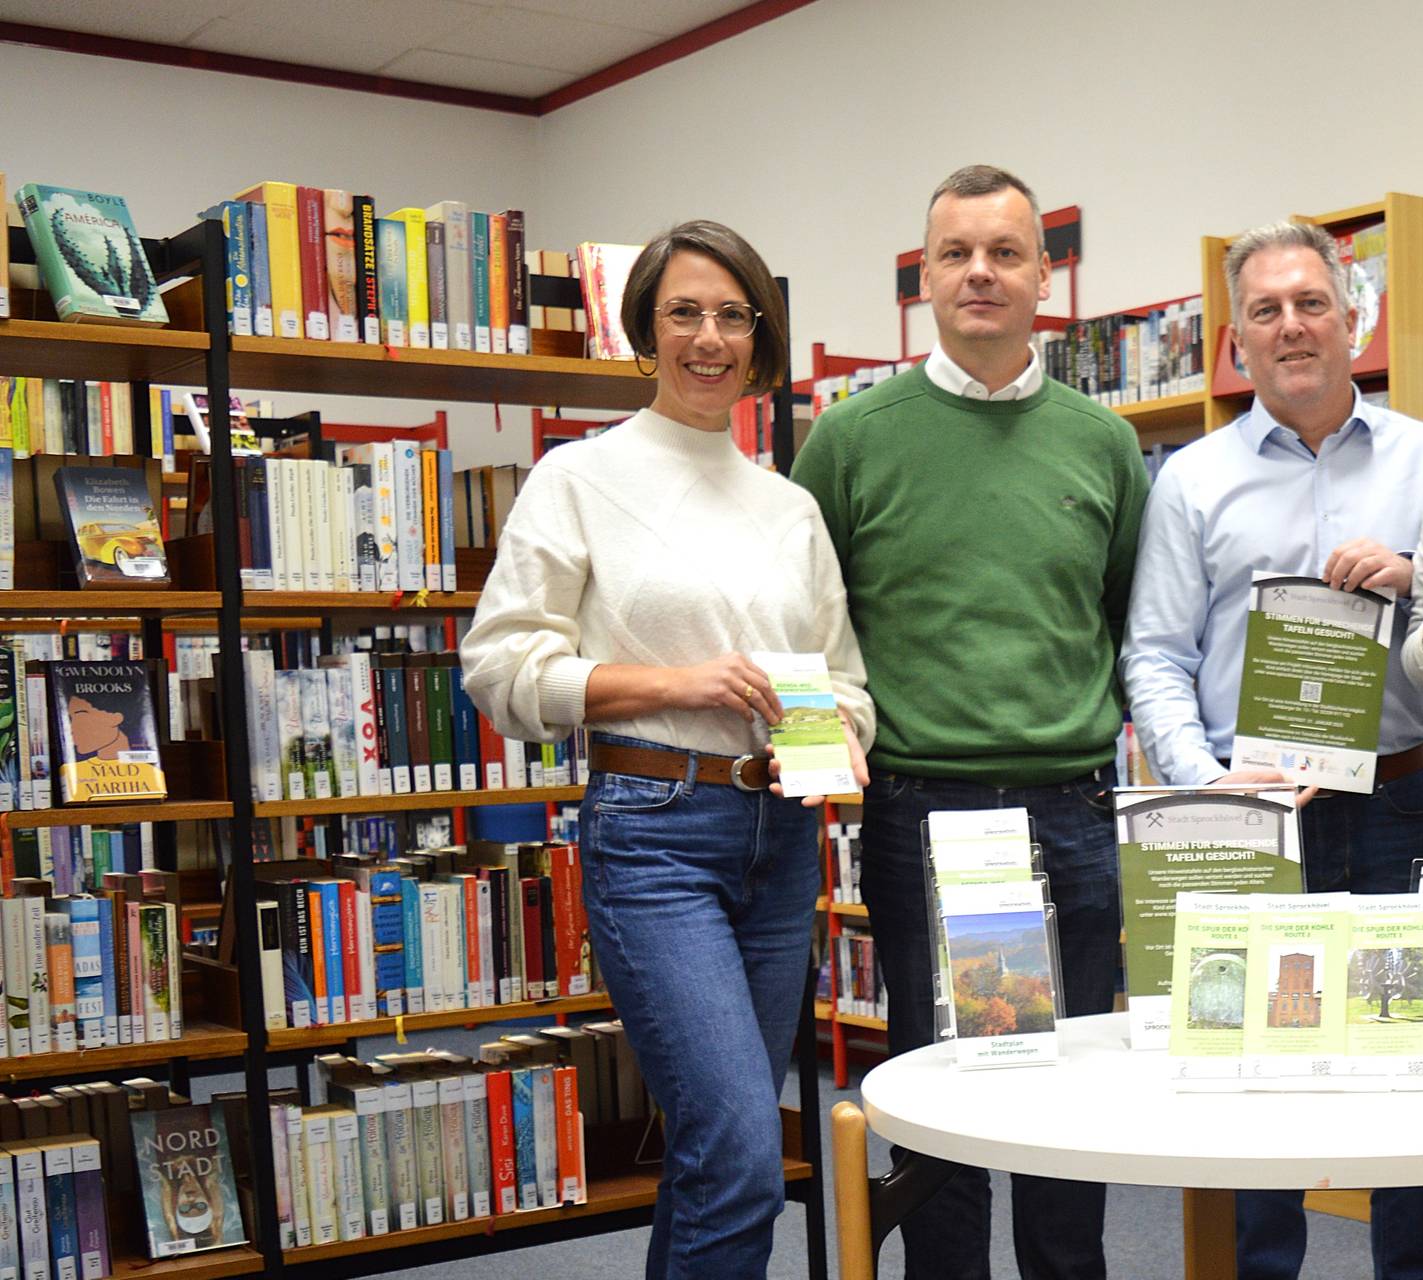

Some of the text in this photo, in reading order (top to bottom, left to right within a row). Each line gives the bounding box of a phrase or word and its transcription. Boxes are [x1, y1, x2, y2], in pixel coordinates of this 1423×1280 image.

[362, 204, 376, 270] BRANDSÄTZE
[84, 495, 100, 504] Die
[102, 495, 128, 504] Fahrt
[58, 665, 144, 677] GWENDOLYN
[75, 682, 132, 694] BROOKS
[360, 698, 378, 762] VOX
[92, 764, 140, 778] MAUD
[85, 782, 150, 795] MARTHA
[1141, 838, 1278, 852] STIMMEN FÜR SPRECHENDE
[1166, 850, 1256, 862] TAFELN GESUCHT!
[296, 888, 308, 954] DEIN IST DAS REICH
[564, 1076, 573, 1116] DAS TING
[394, 1109, 406, 1140] Fotogra
[422, 1105, 434, 1136] Fotogra
[448, 1102, 459, 1133] Fotogra
[471, 1098, 482, 1128] Fotogra
[143, 1128, 220, 1154] NORD
[367, 1114, 378, 1144] Fotogra
[149, 1156, 225, 1182] STADT
[498, 1158, 514, 1182] Sisi
